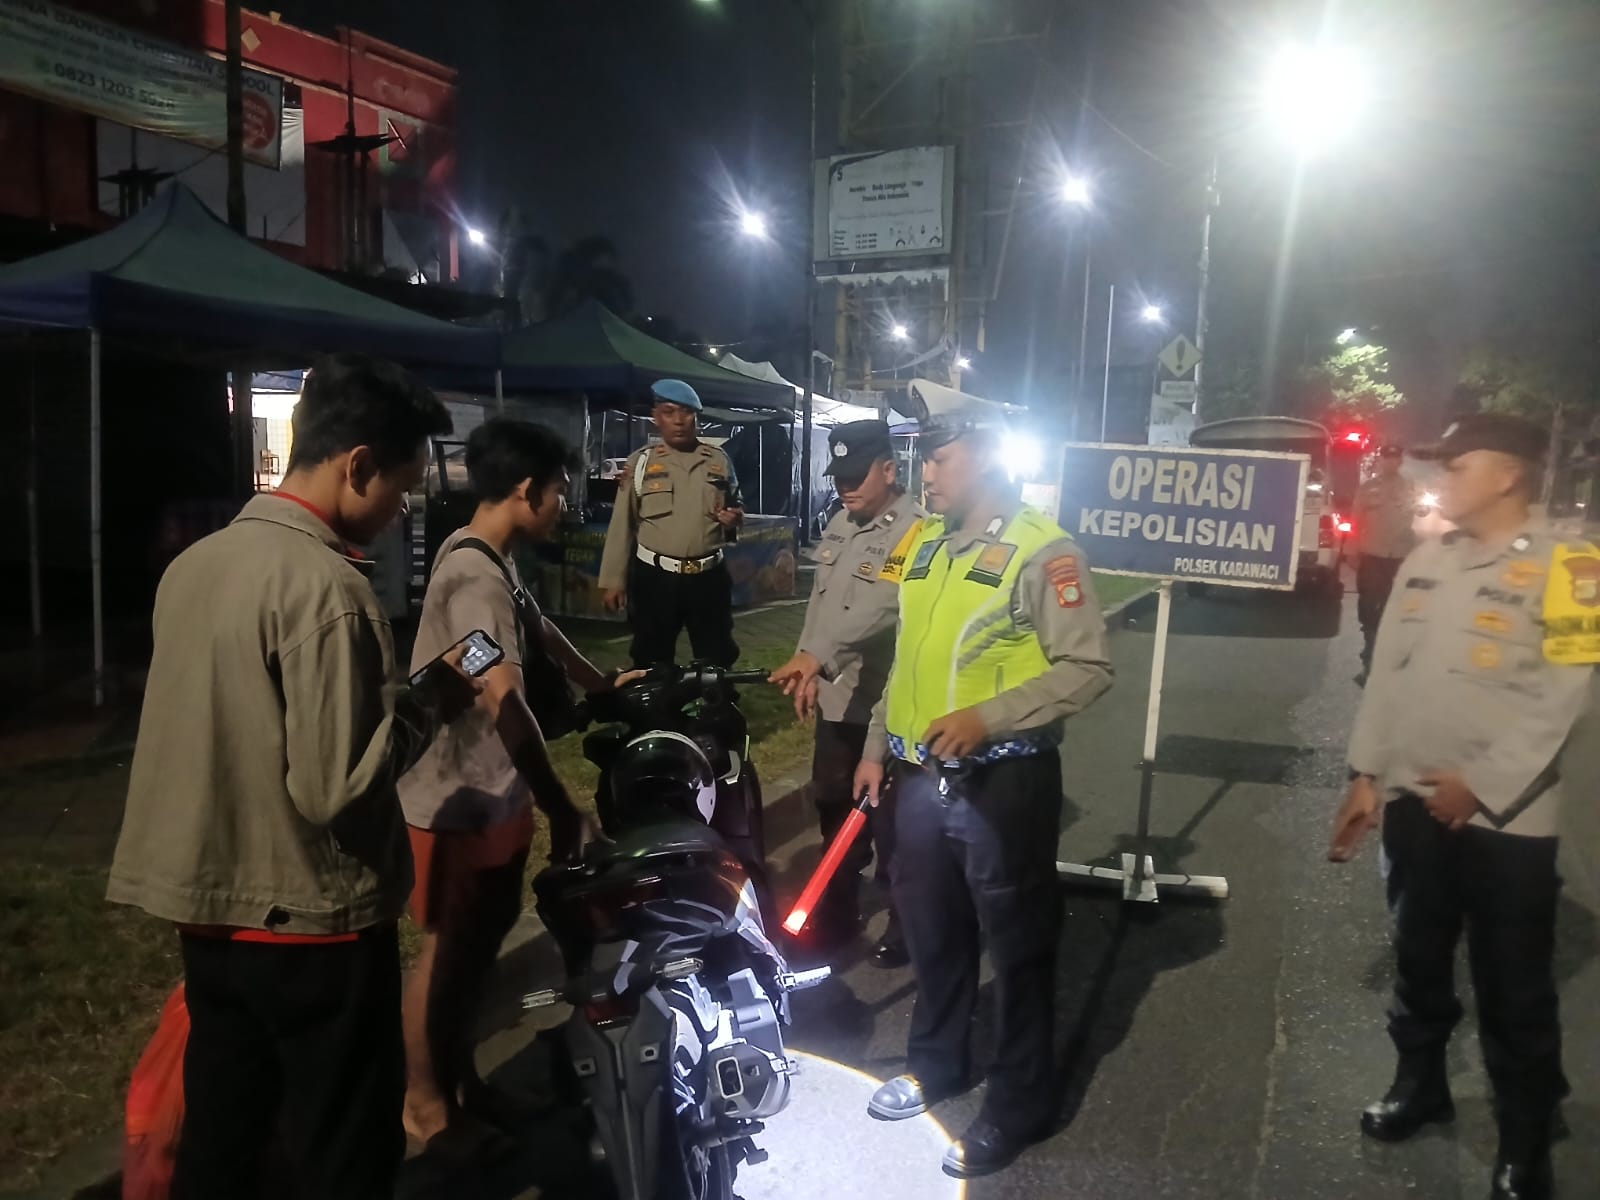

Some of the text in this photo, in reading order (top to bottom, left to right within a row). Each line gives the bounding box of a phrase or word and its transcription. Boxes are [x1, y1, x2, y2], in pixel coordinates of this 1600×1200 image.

[54, 62, 97, 88] 0823
[100, 76, 136, 99] 1203
[216, 66, 275, 97] SOOL
[1108, 455, 1256, 511] OPERASI
[1078, 507, 1276, 552] KEPOLISIAN
[1173, 557, 1280, 580] POLSEK KARAWACI
